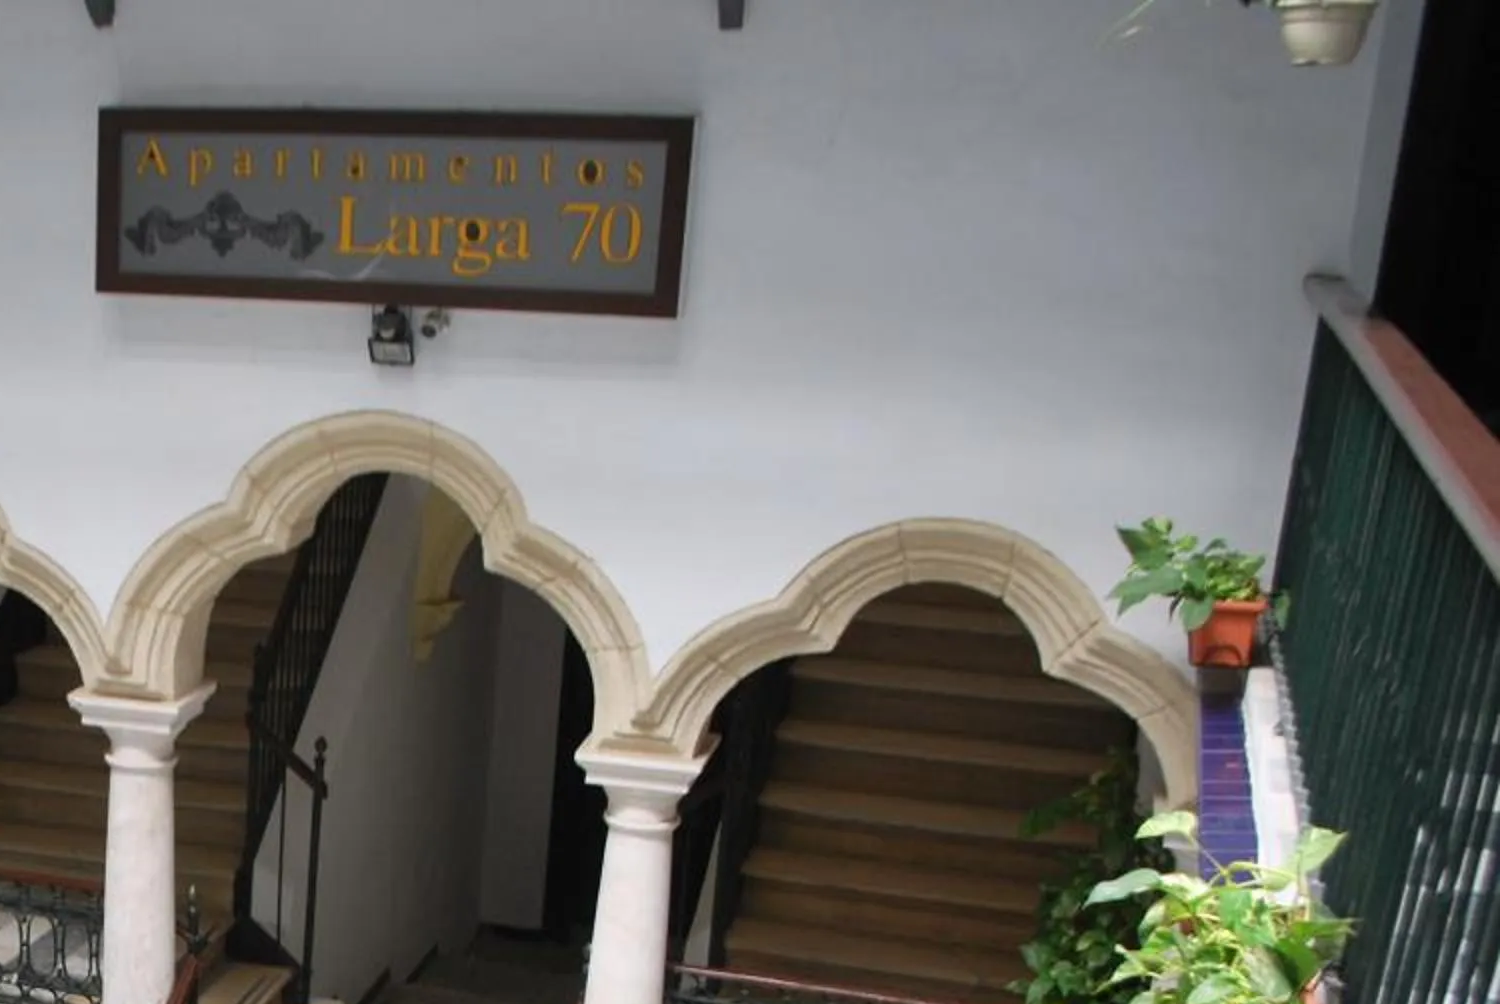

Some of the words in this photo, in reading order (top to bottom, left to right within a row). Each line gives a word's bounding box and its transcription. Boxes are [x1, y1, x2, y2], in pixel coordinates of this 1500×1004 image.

[136, 136, 644, 188] Apartamentos
[336, 195, 531, 277] Larga
[560, 202, 643, 264] 70
